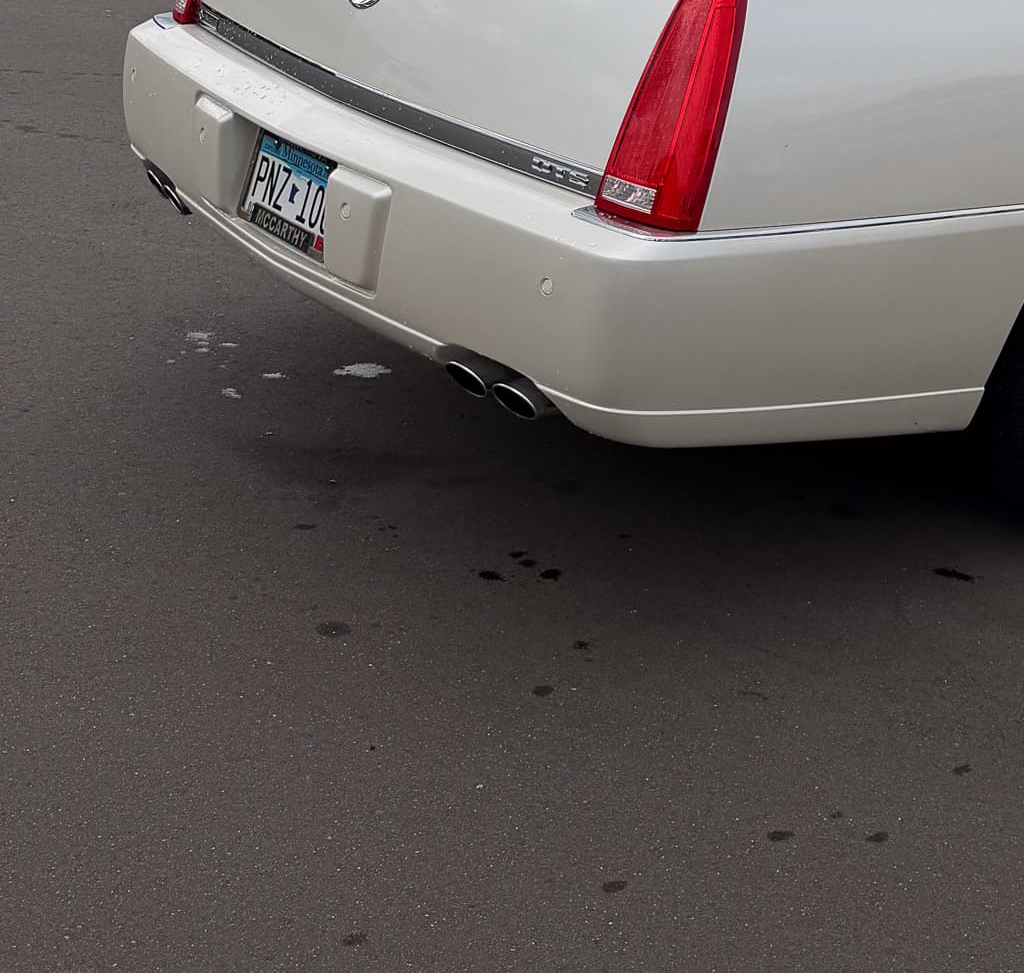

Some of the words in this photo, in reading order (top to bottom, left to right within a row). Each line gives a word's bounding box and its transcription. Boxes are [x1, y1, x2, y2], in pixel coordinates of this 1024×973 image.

[281, 143, 323, 175] Minnesota
[251, 155, 292, 212] PNZ
[296, 179, 325, 235] 10
[255, 209, 308, 249] MCCARTHY
